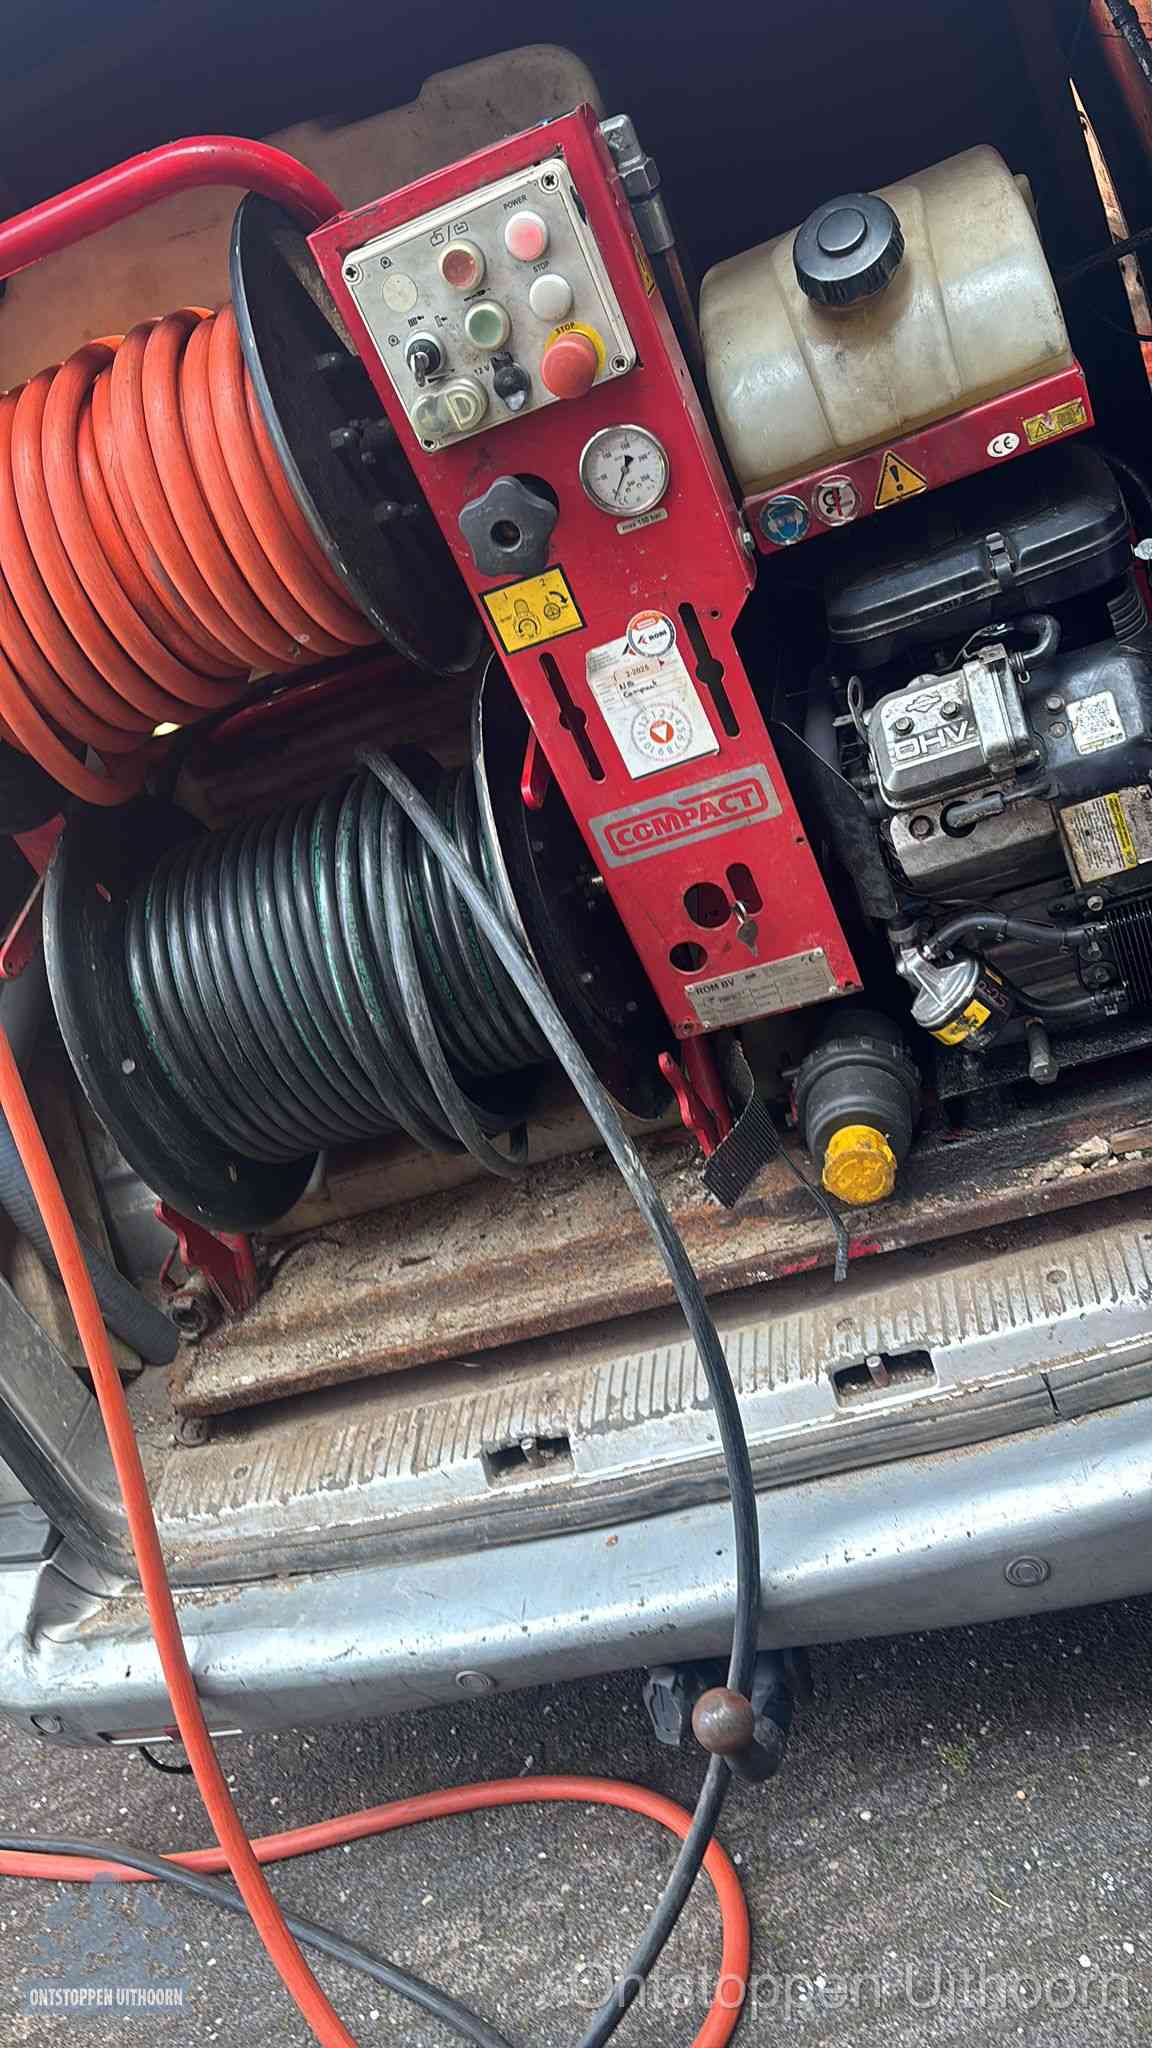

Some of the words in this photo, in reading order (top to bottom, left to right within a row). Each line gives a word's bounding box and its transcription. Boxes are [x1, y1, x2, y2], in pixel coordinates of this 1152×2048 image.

[503, 194, 528, 210] POWER
[533, 260, 550, 273] STOP
[555, 321, 576, 335] STOP
[992, 434, 1016, 454] CE
[895, 719, 969, 761] OHV
[616, 787, 755, 846] COMPACT
